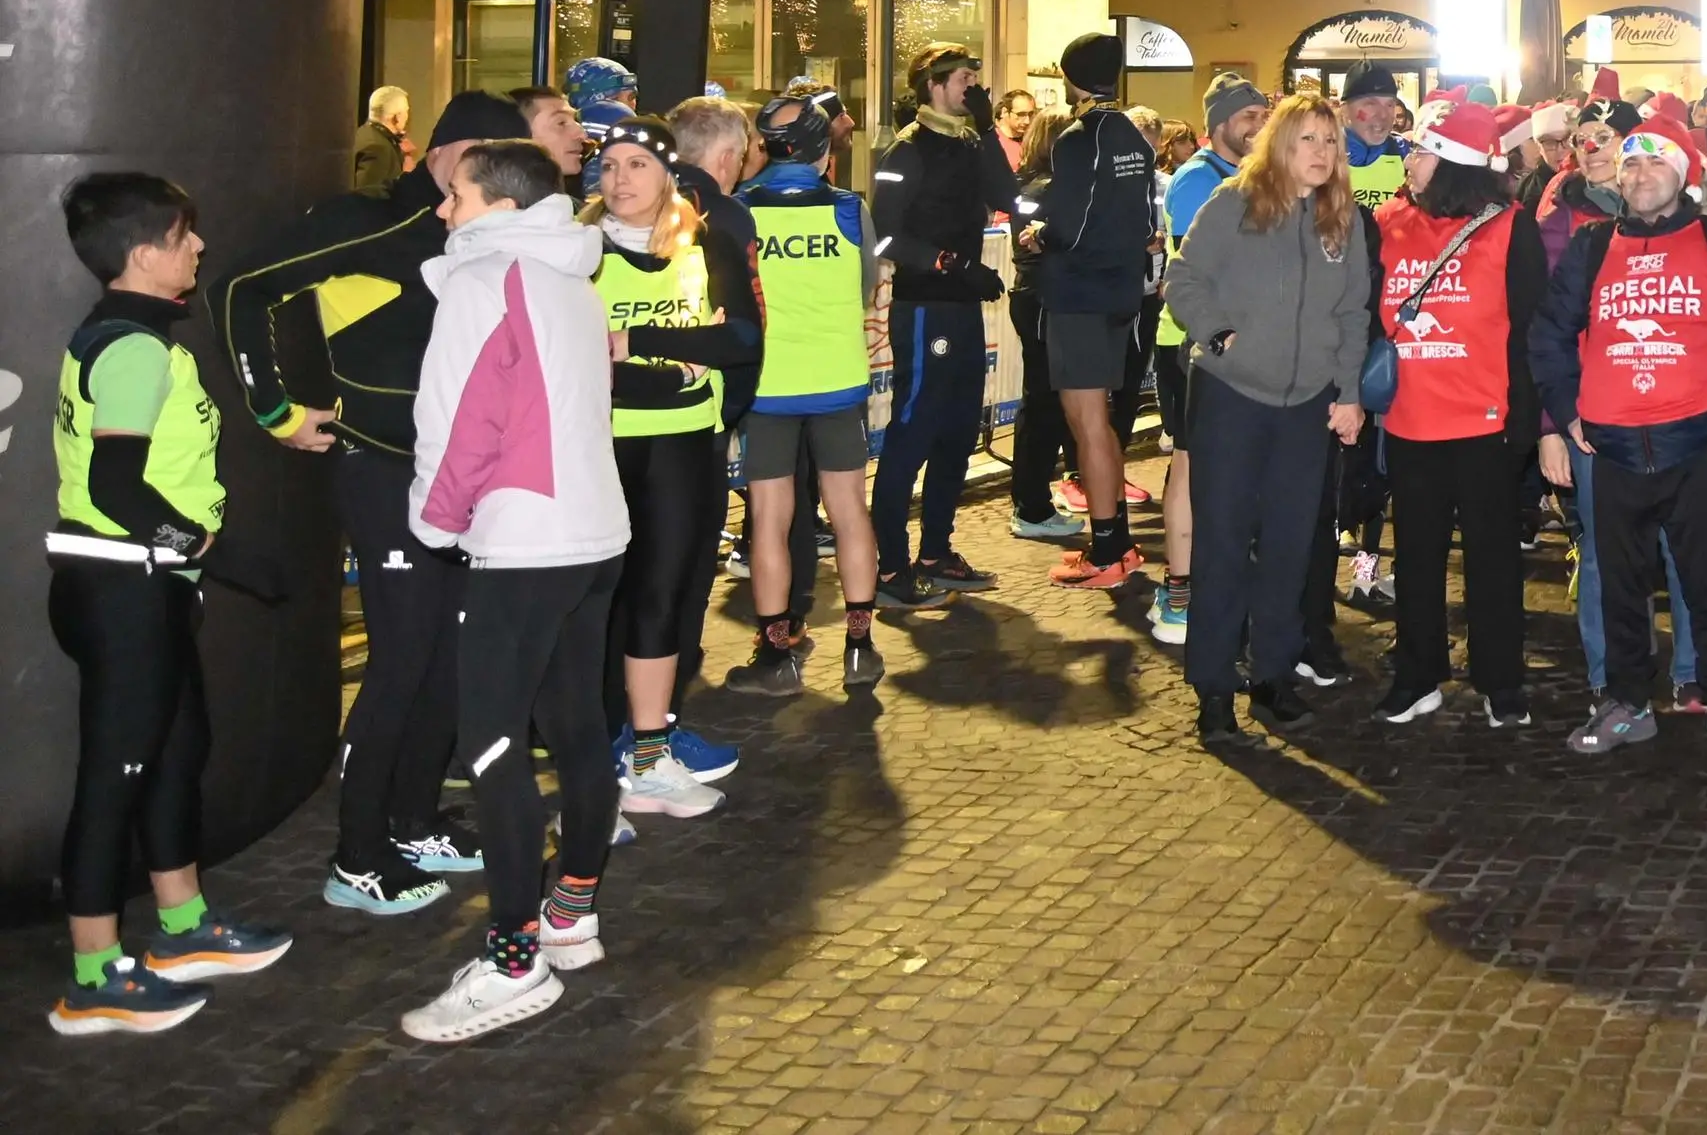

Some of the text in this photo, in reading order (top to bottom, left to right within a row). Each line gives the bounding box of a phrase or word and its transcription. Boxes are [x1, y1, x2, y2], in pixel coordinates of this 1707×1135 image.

[1340, 24, 1408, 50] Mameli
[1394, 258, 1461, 275] AMO
[1600, 276, 1702, 303] SPECIAL
[1598, 297, 1702, 322] RUNNER
